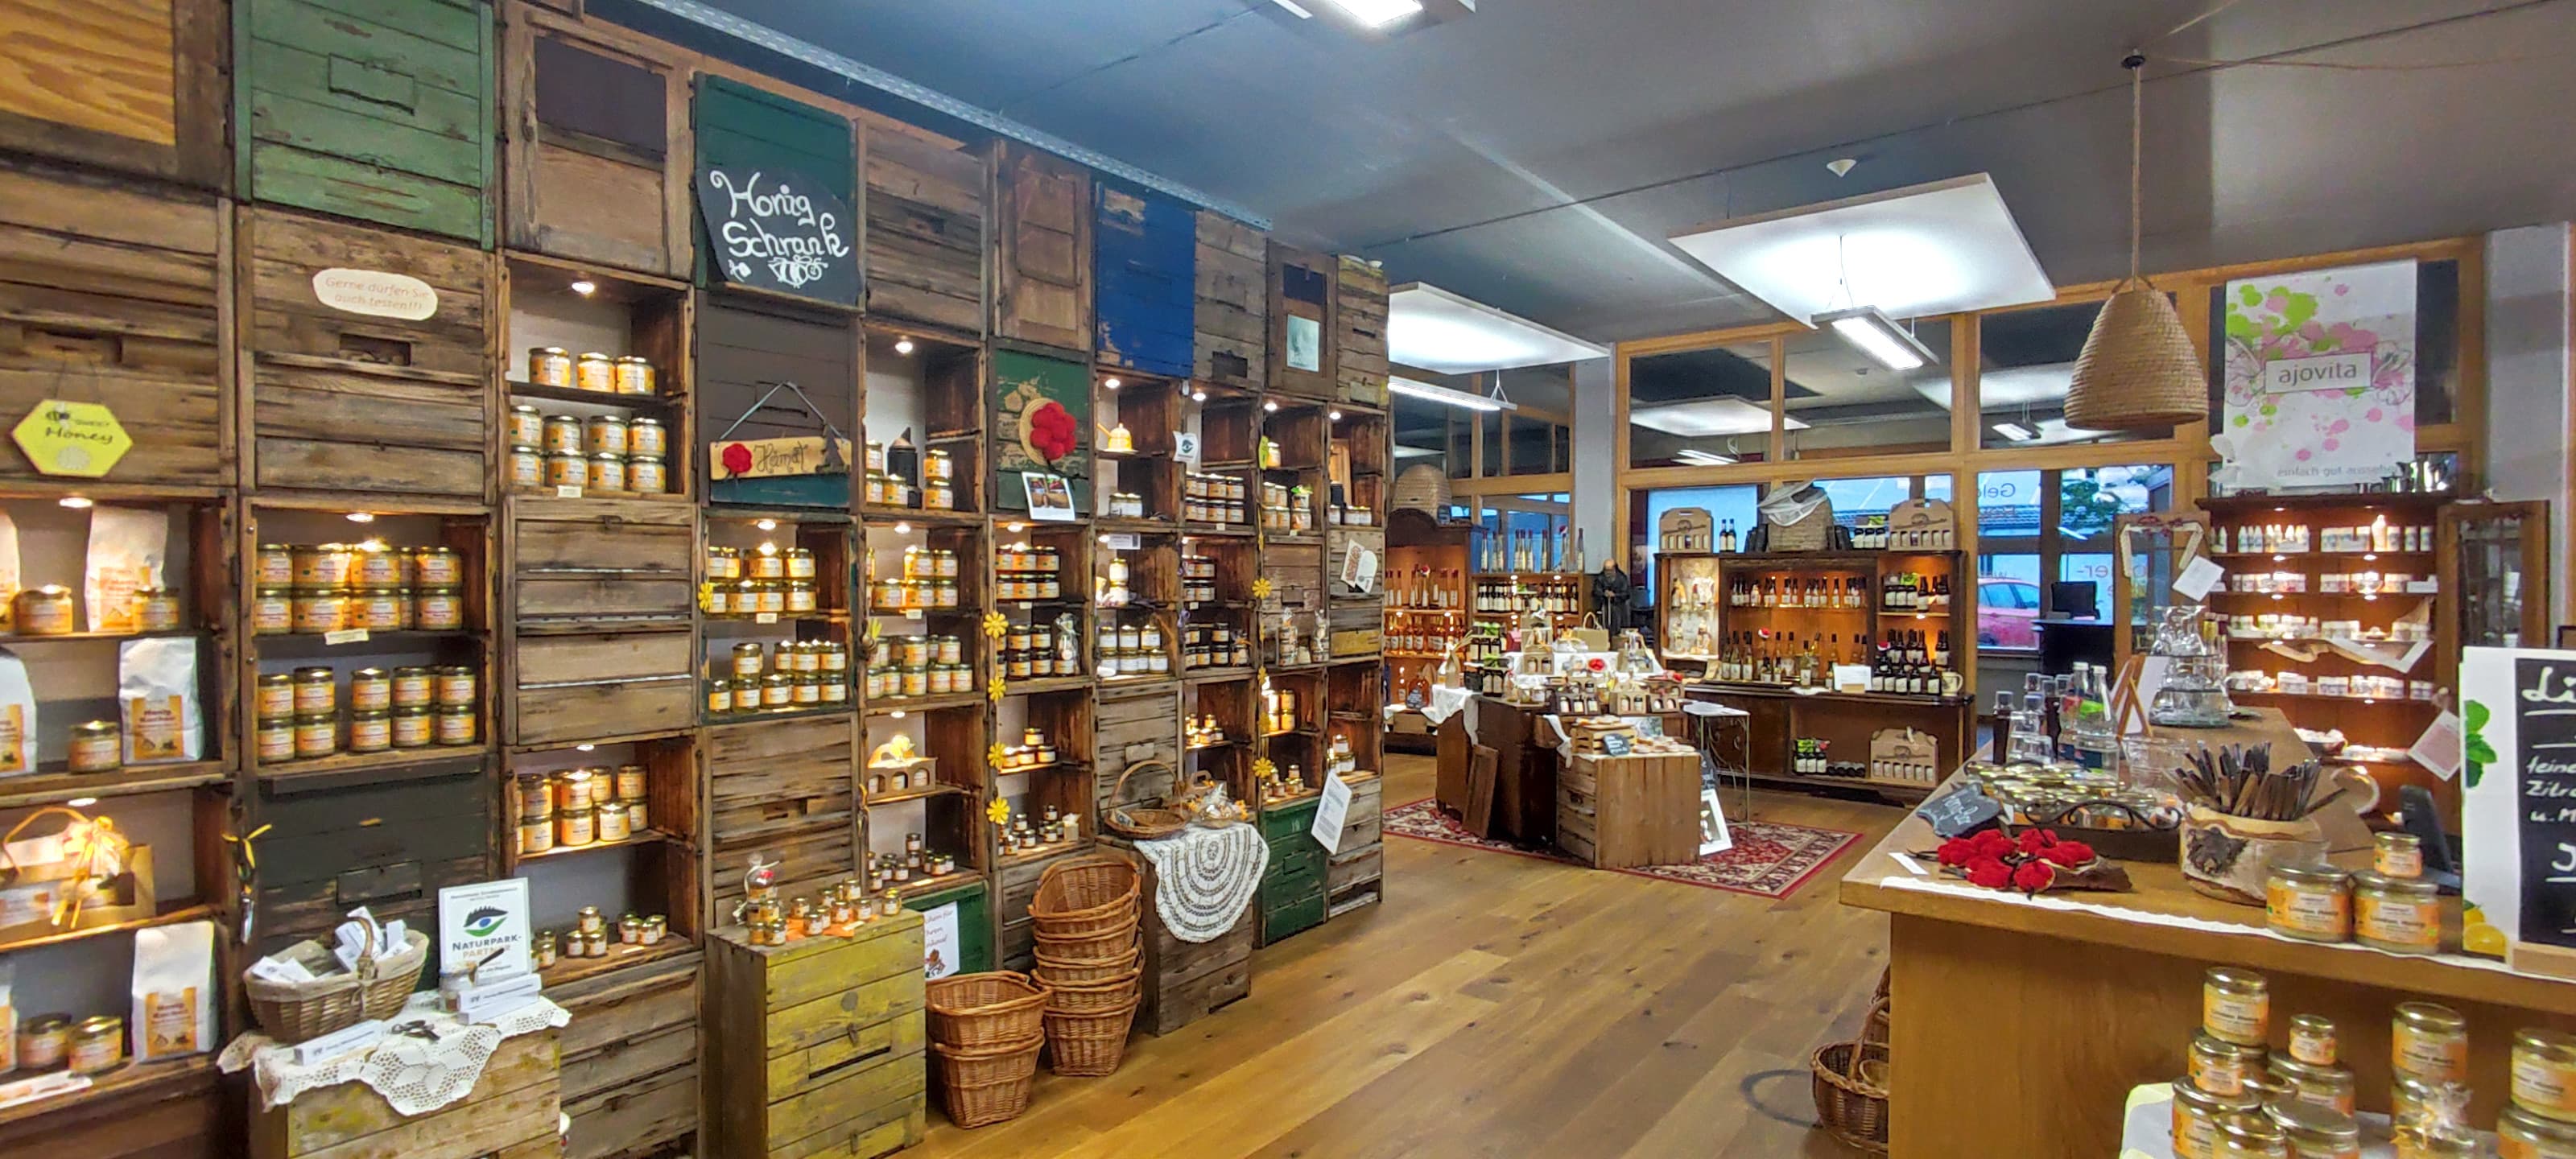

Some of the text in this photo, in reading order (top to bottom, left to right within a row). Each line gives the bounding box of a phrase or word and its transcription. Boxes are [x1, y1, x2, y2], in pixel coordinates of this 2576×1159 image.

[710, 170, 815, 227] Honig
[722, 212, 849, 257] Schrank
[325, 276, 365, 291] Gerne
[334, 293, 365, 304] auch
[2279, 361, 2357, 386] ajovita
[45, 426, 113, 445] Honey
[463, 944, 510, 959] PARTNR
